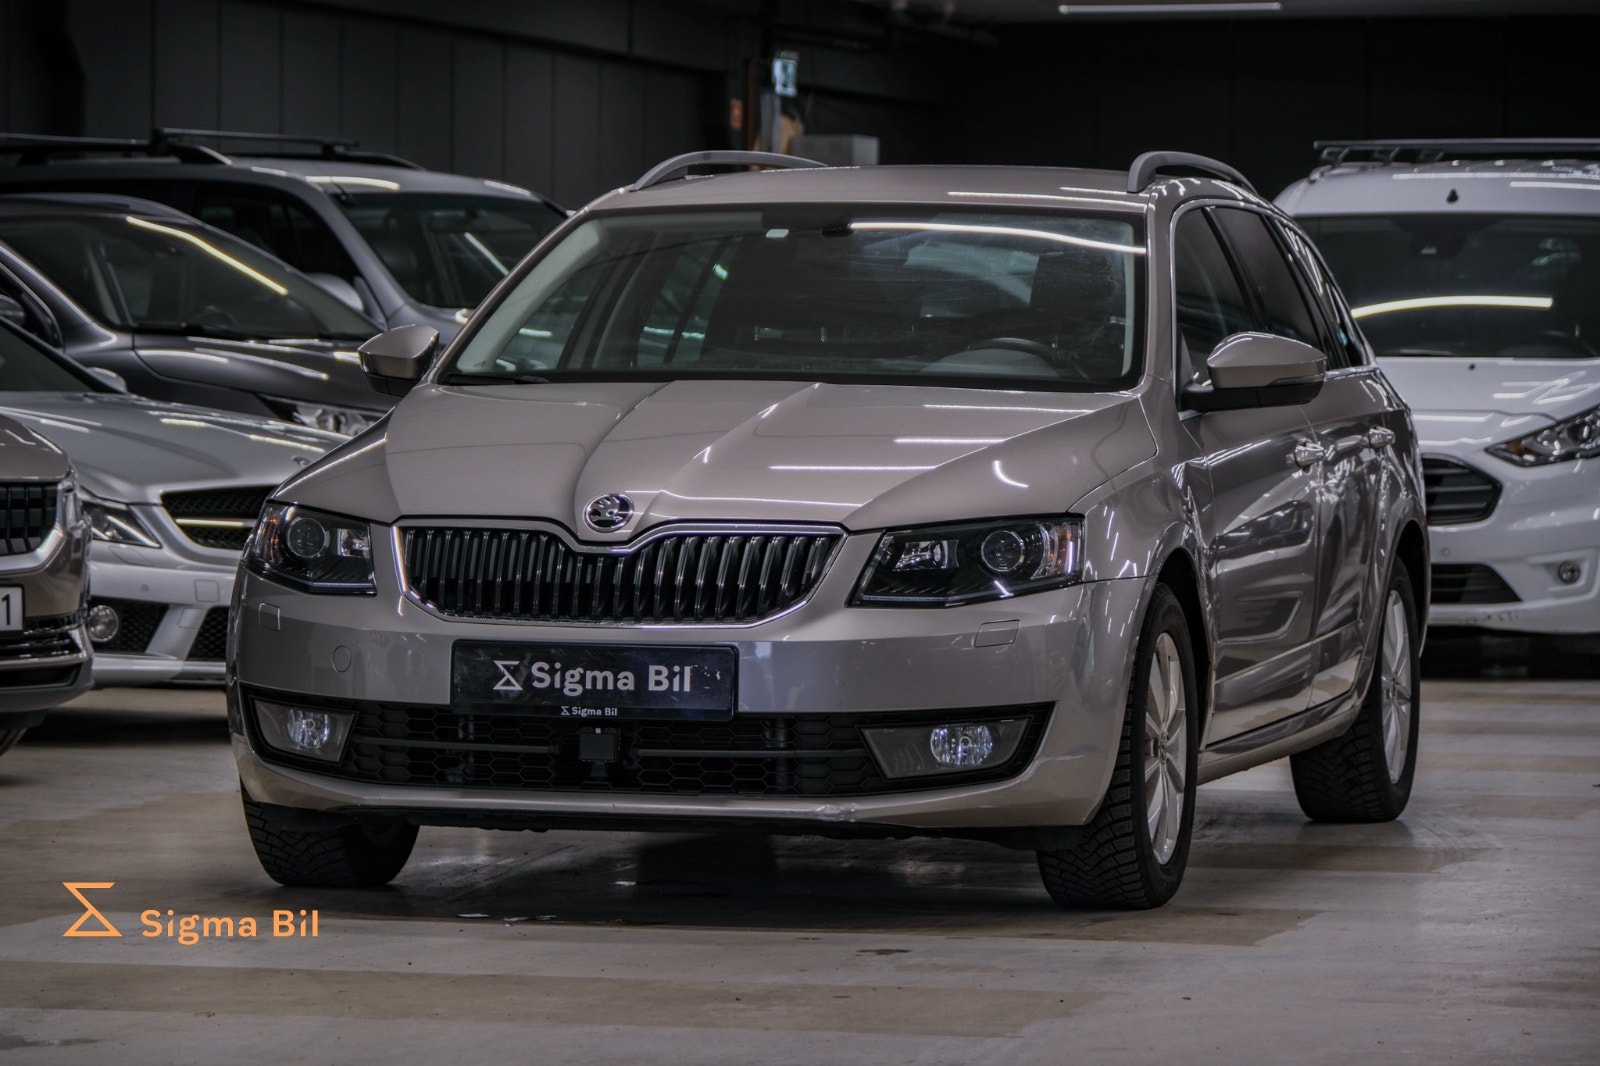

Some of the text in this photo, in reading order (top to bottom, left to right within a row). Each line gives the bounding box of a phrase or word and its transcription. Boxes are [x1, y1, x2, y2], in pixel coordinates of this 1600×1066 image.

[531, 661, 691, 697] Sigma Bil
[571, 706, 618, 718] Sigma Bil
